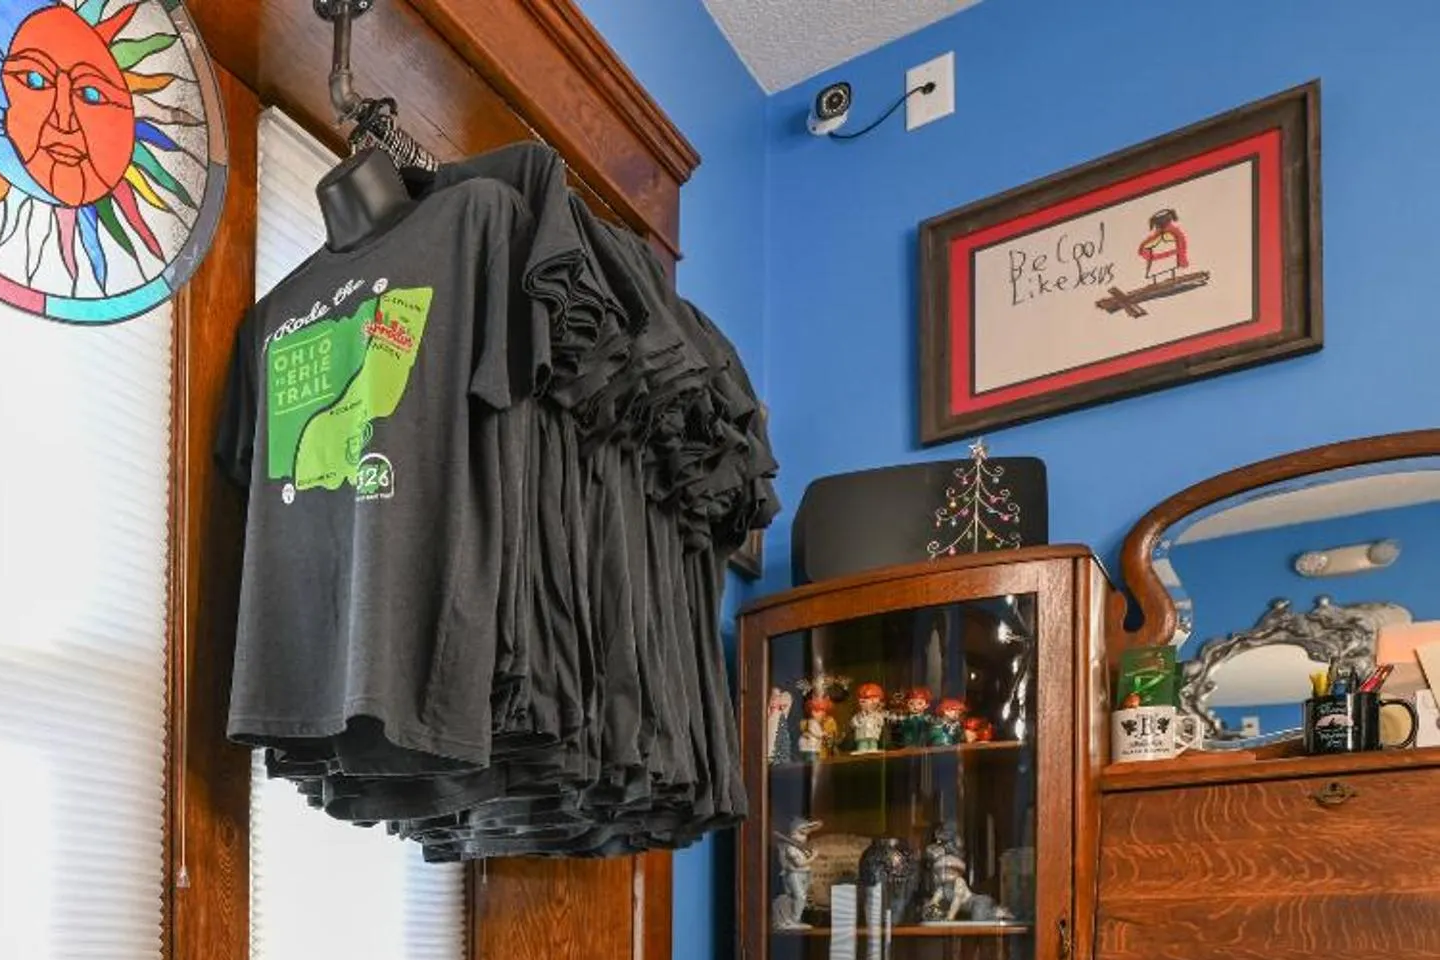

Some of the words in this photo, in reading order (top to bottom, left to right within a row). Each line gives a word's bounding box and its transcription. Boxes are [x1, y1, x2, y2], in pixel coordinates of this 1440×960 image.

[1008, 249, 1048, 283] Be
[1056, 221, 1105, 264] Cool
[1011, 273, 1068, 306] Like
[1072, 258, 1115, 289] Jesus
[273, 338, 332, 372] OHIO
[287, 354, 331, 386] ERIE
[274, 373, 333, 406] TRAIL
